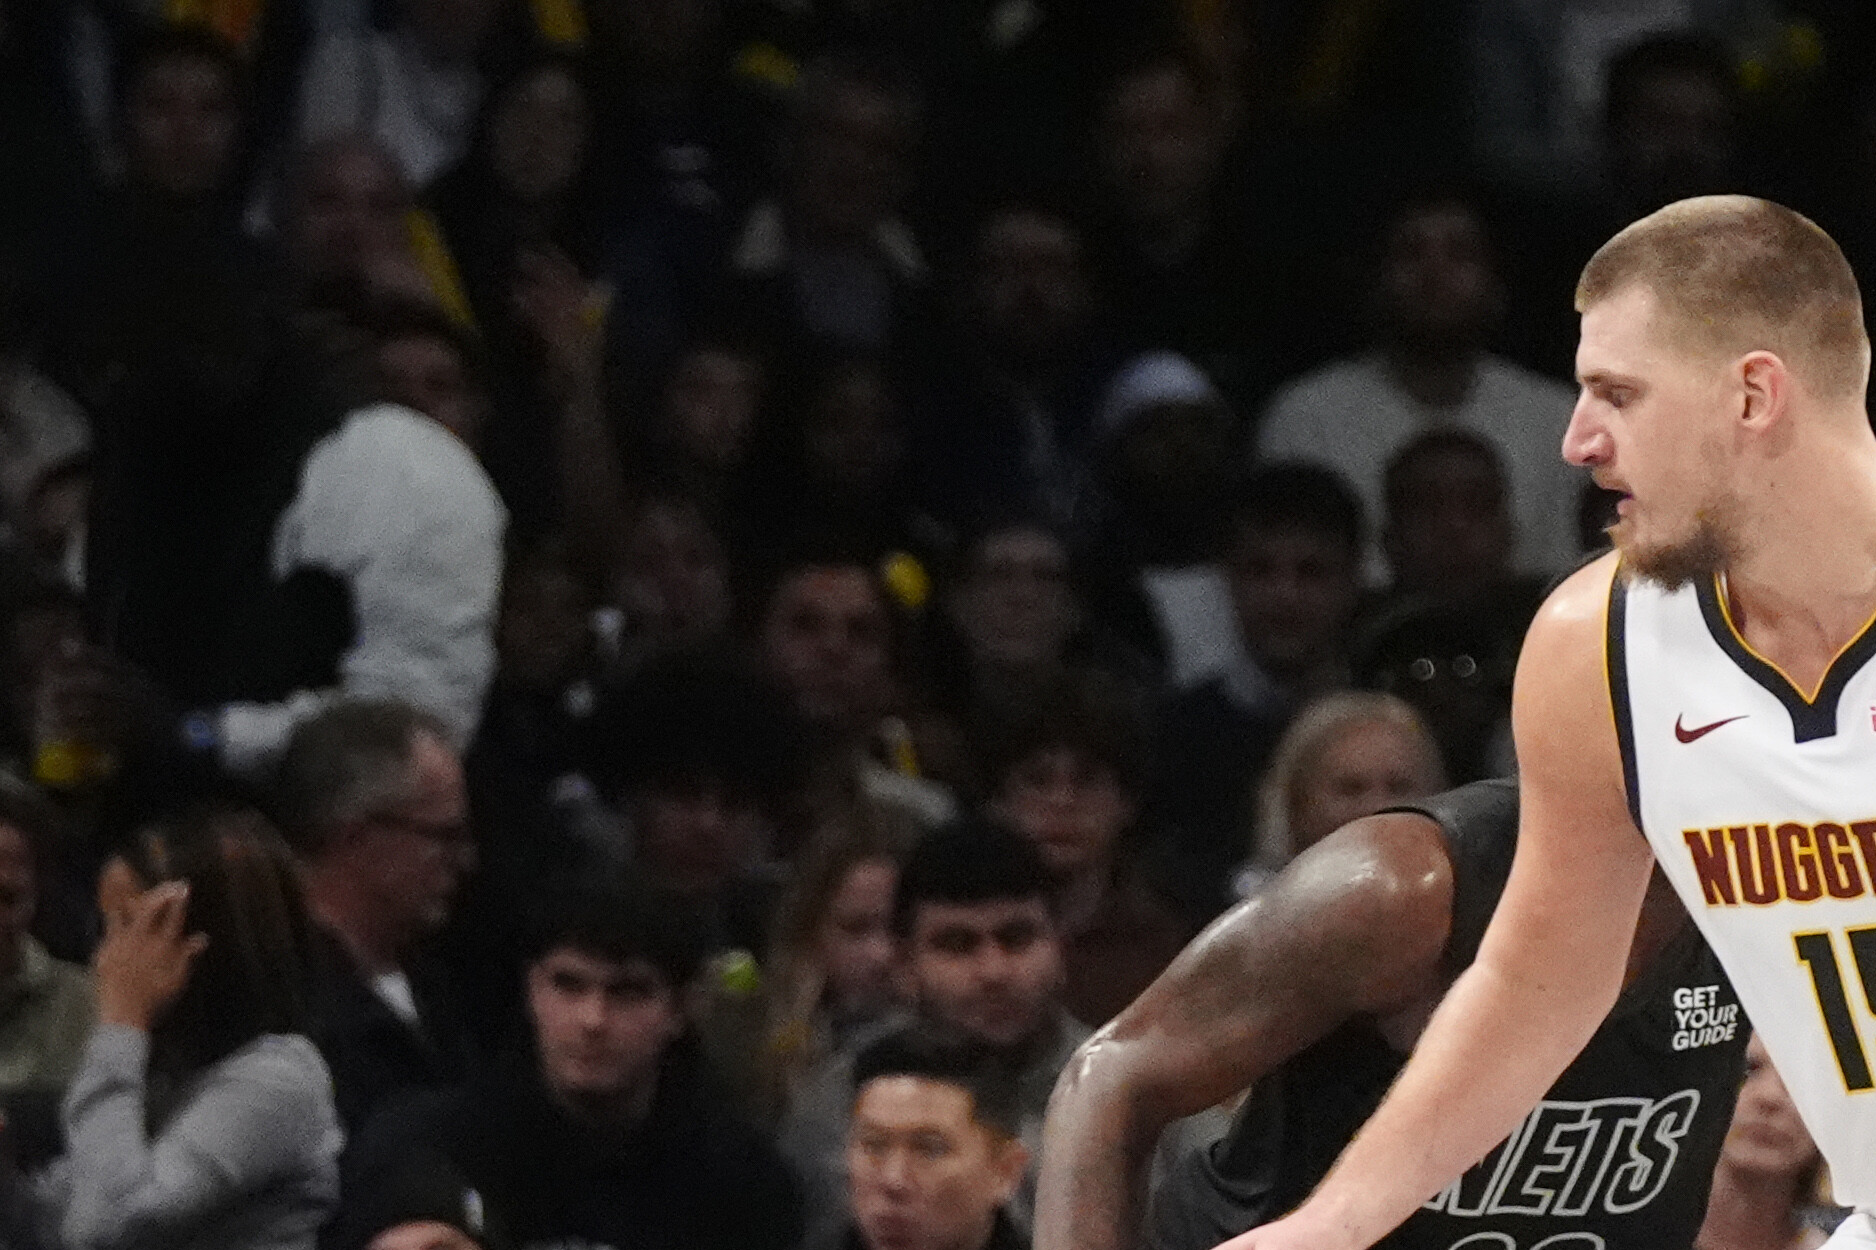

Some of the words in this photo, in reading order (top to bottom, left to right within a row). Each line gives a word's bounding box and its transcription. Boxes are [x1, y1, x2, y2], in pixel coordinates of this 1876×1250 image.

[1673, 984, 1720, 1010] GET
[1674, 1003, 1739, 1031] YOUR
[1671, 1022, 1739, 1052] GUIDE
